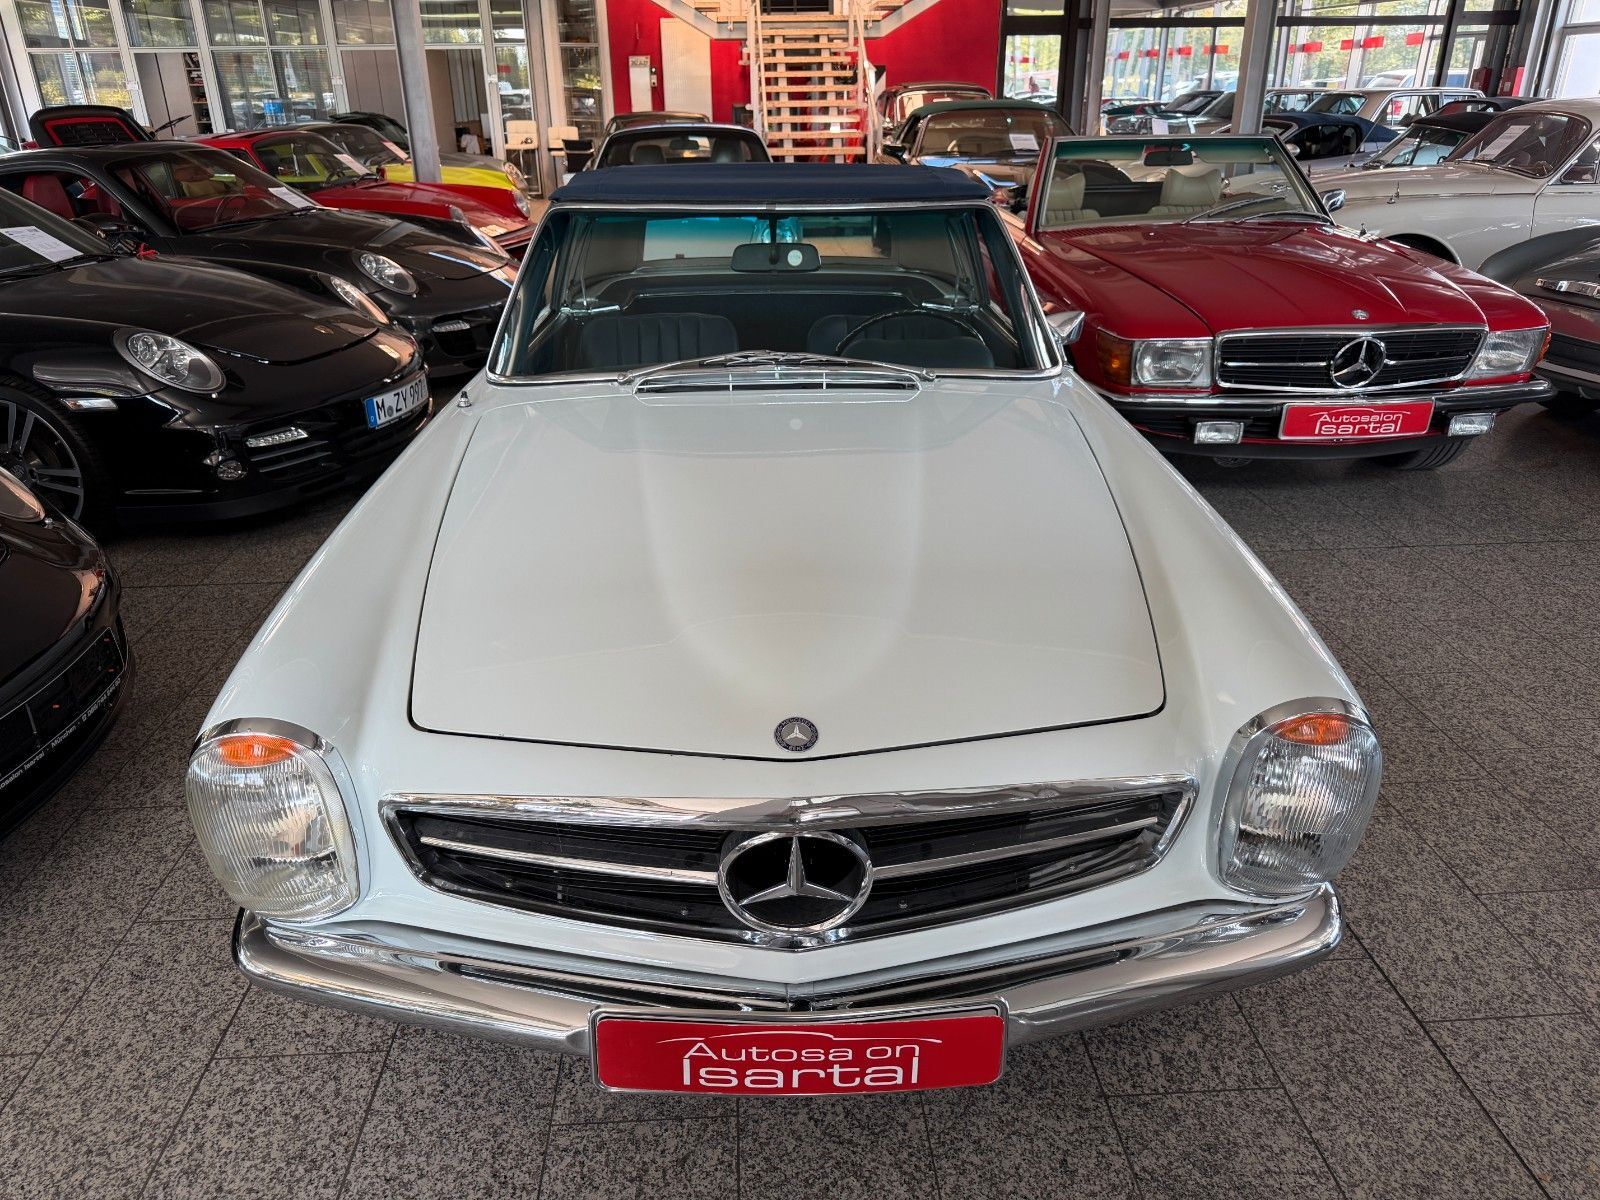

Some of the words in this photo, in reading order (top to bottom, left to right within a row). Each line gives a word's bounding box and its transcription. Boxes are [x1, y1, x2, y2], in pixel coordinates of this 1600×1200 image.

[376, 399, 386, 420] M
[394, 388, 407, 413] ZY
[410, 379, 423, 405] 997
[1314, 420, 1402, 435] Isartal
[1319, 413, 1403, 422] Autosalon
[683, 1057, 920, 1089] Isartal
